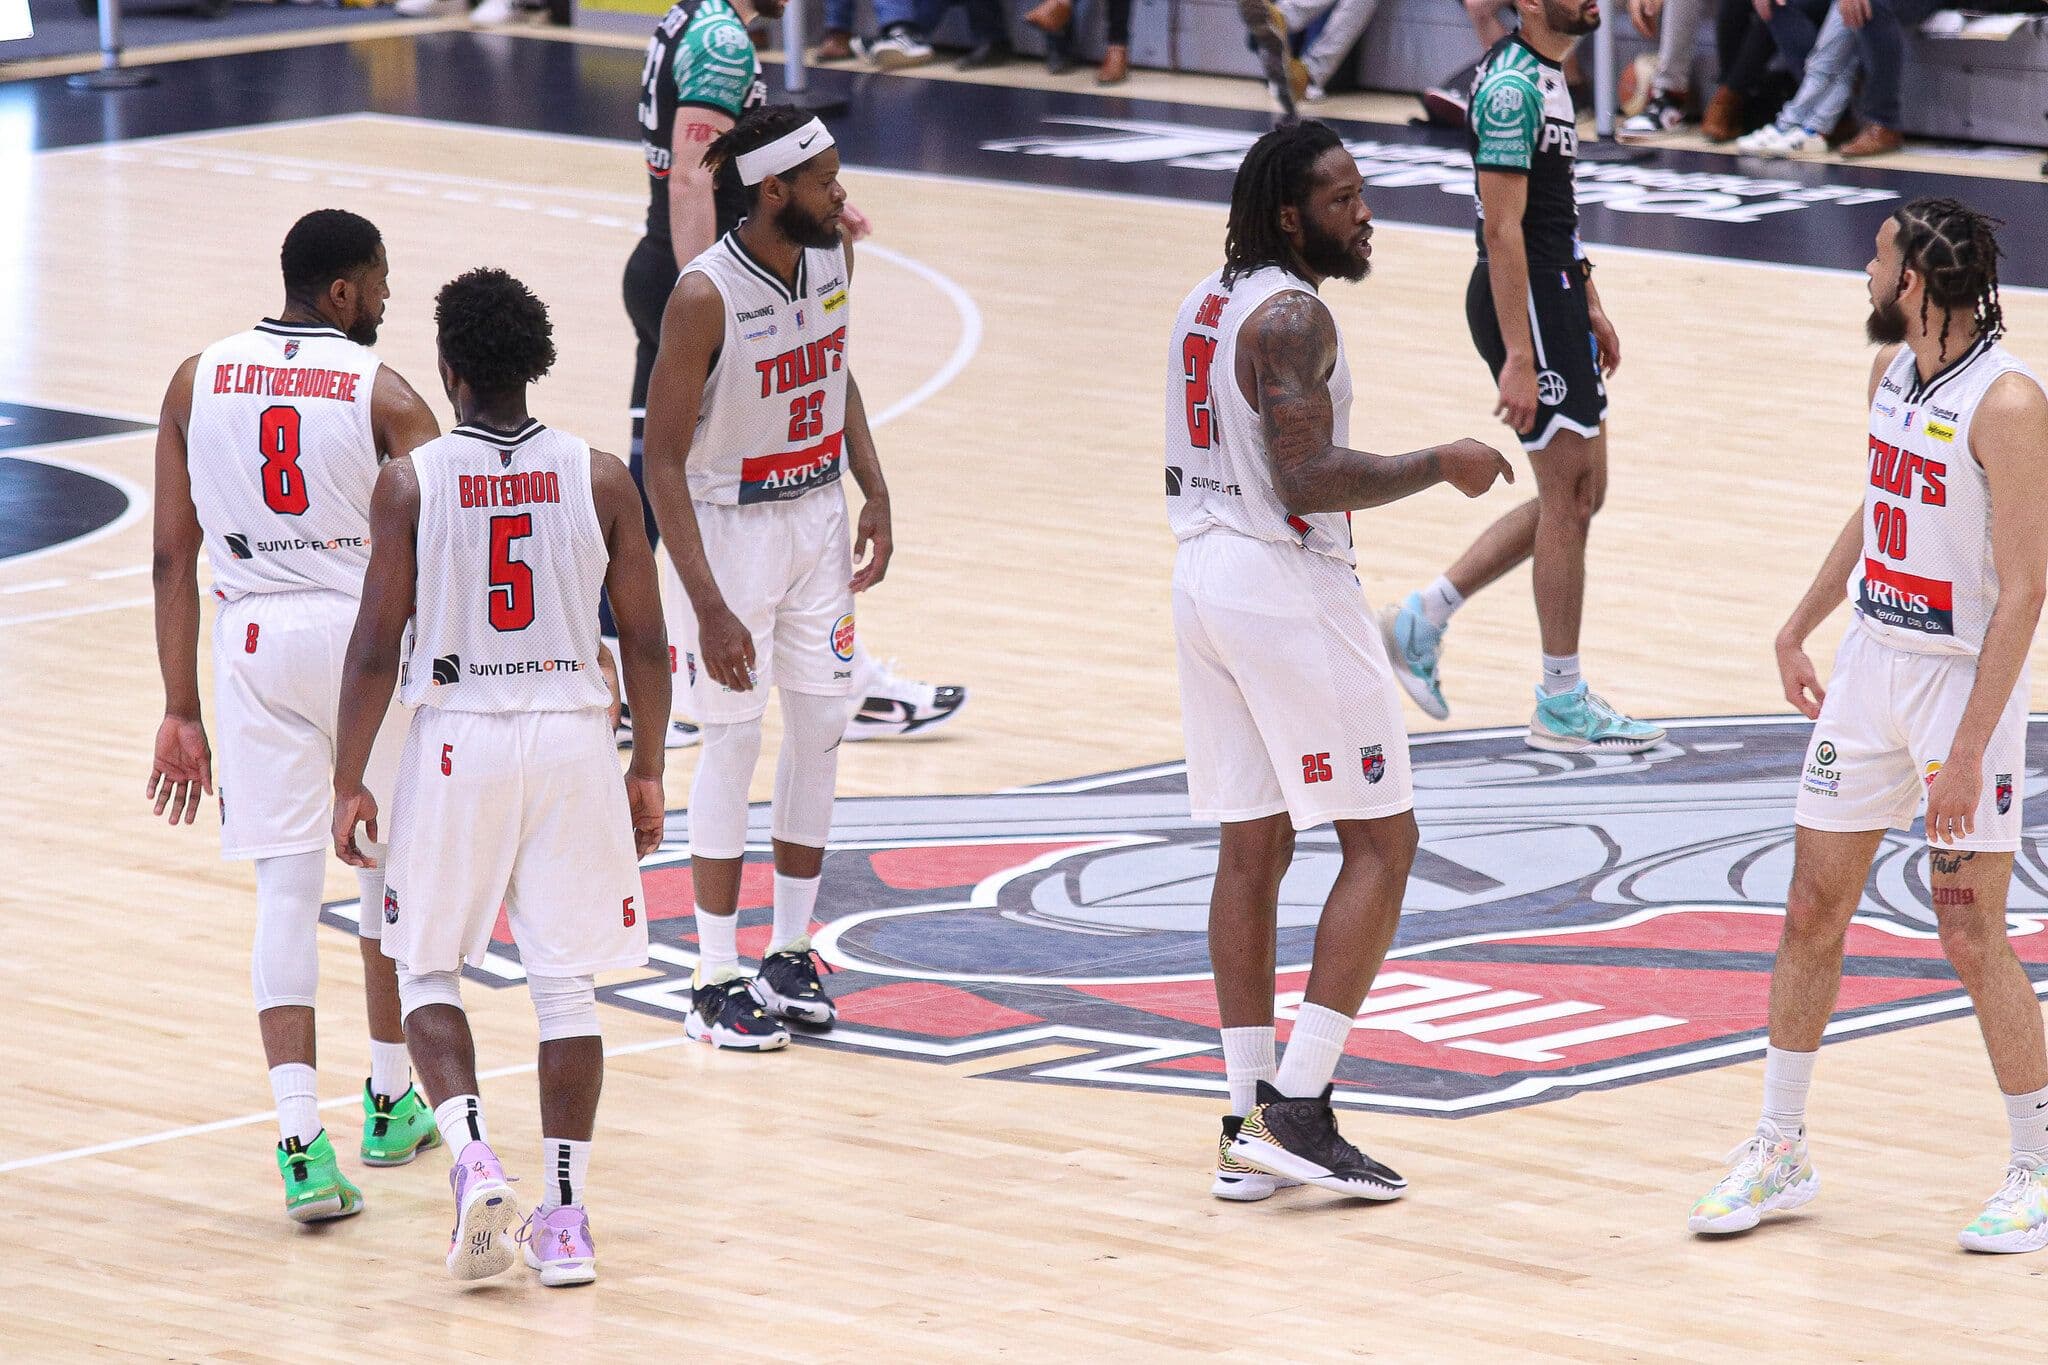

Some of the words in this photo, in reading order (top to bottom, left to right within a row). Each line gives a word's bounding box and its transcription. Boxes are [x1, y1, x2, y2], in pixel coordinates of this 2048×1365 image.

[213, 364, 234, 394] DE
[1182, 332, 1221, 450] 2
[788, 390, 826, 442] 23
[258, 405, 310, 516] 8
[761, 452, 833, 490] ARTUS
[257, 540, 292, 552] SUIVI
[1873, 501, 1908, 561] 00
[488, 513, 535, 632] 5
[1865, 578, 1929, 614] ARTUS
[244, 622, 260, 654] 8
[469, 663, 503, 676] SUIVI
[506, 662, 525, 675] DE
[440, 743, 454, 777] 5
[1302, 752, 1333, 784] 25
[1806, 763, 1842, 780] JARDI
[622, 896, 636, 928] 5
